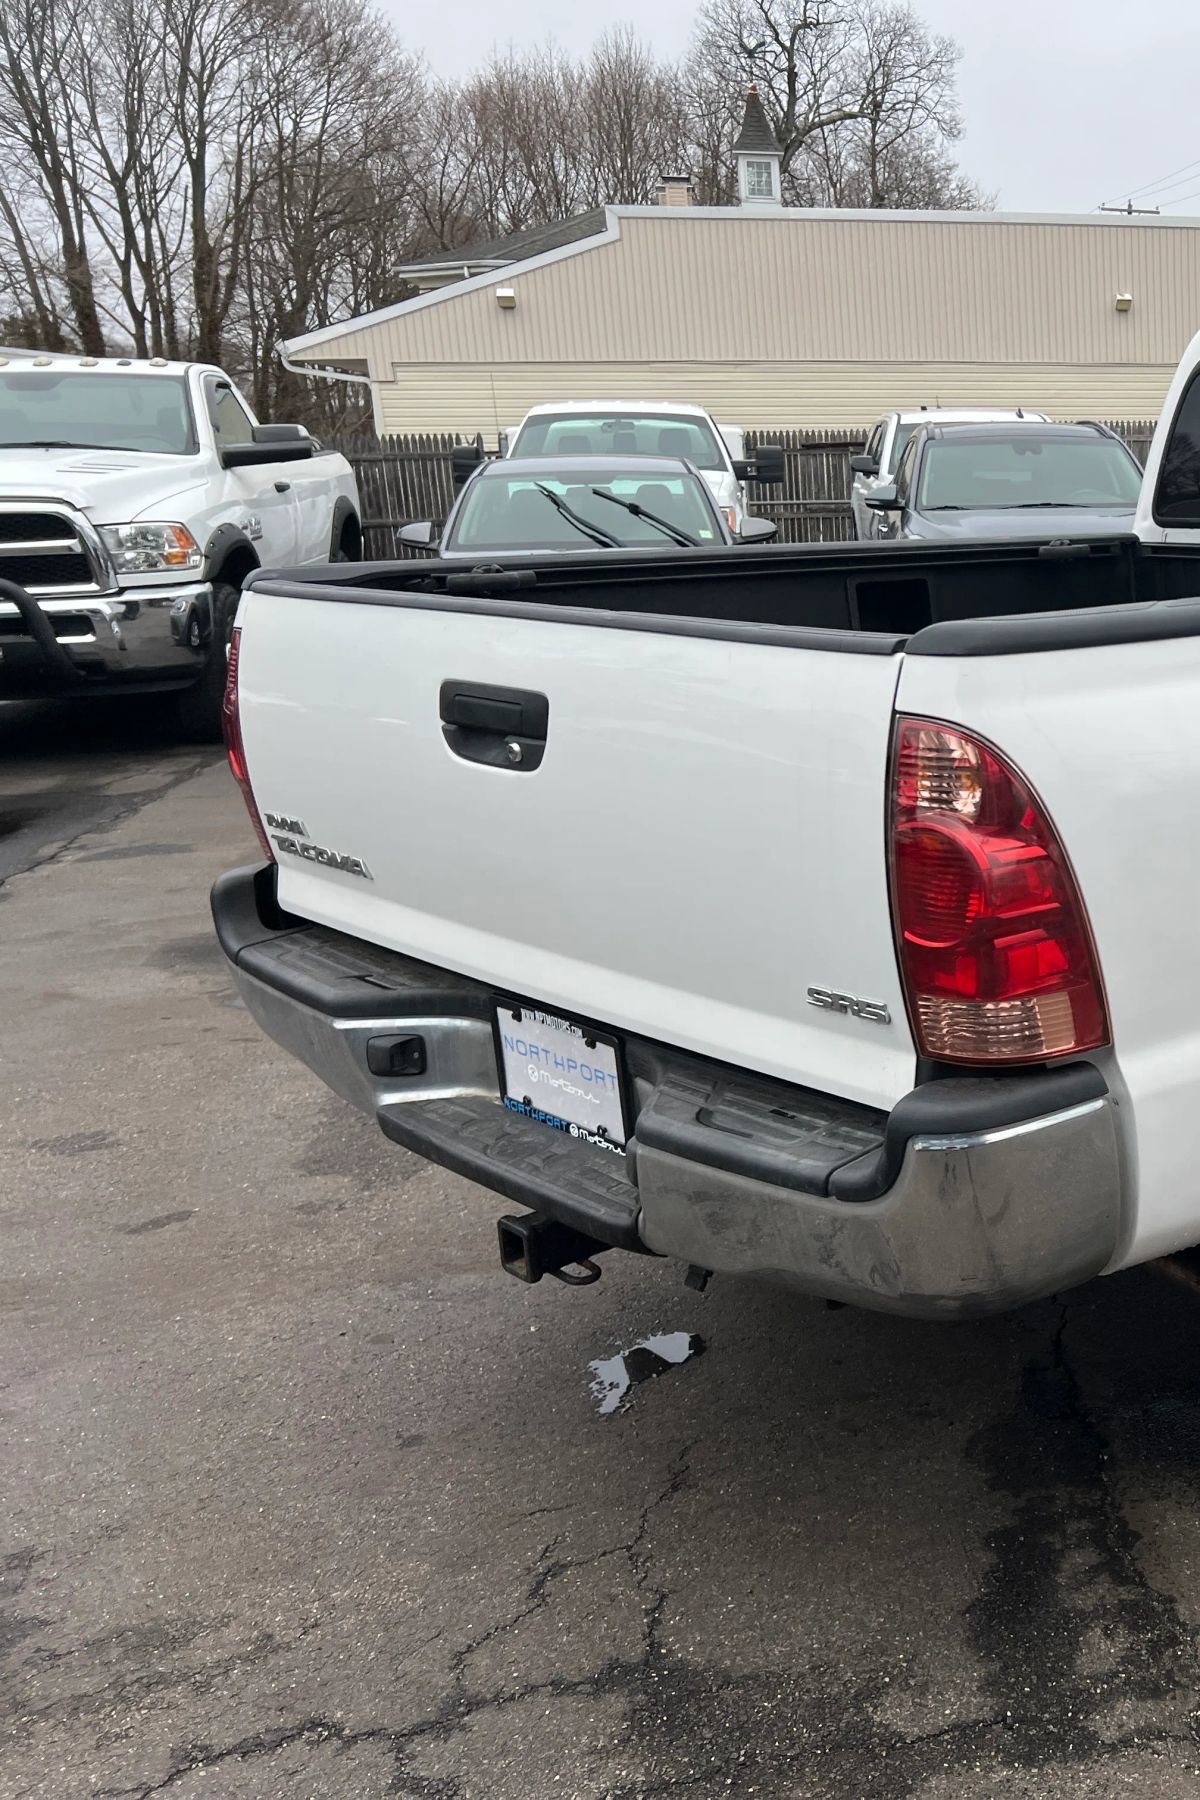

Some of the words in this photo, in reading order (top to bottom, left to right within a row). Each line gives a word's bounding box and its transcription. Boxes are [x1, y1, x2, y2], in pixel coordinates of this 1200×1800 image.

[271, 833, 375, 881] TACOMA
[806, 985, 892, 1026] SR5
[503, 1034, 617, 1091] NORTHPORT
[503, 1095, 568, 1131] NORTHPORT
